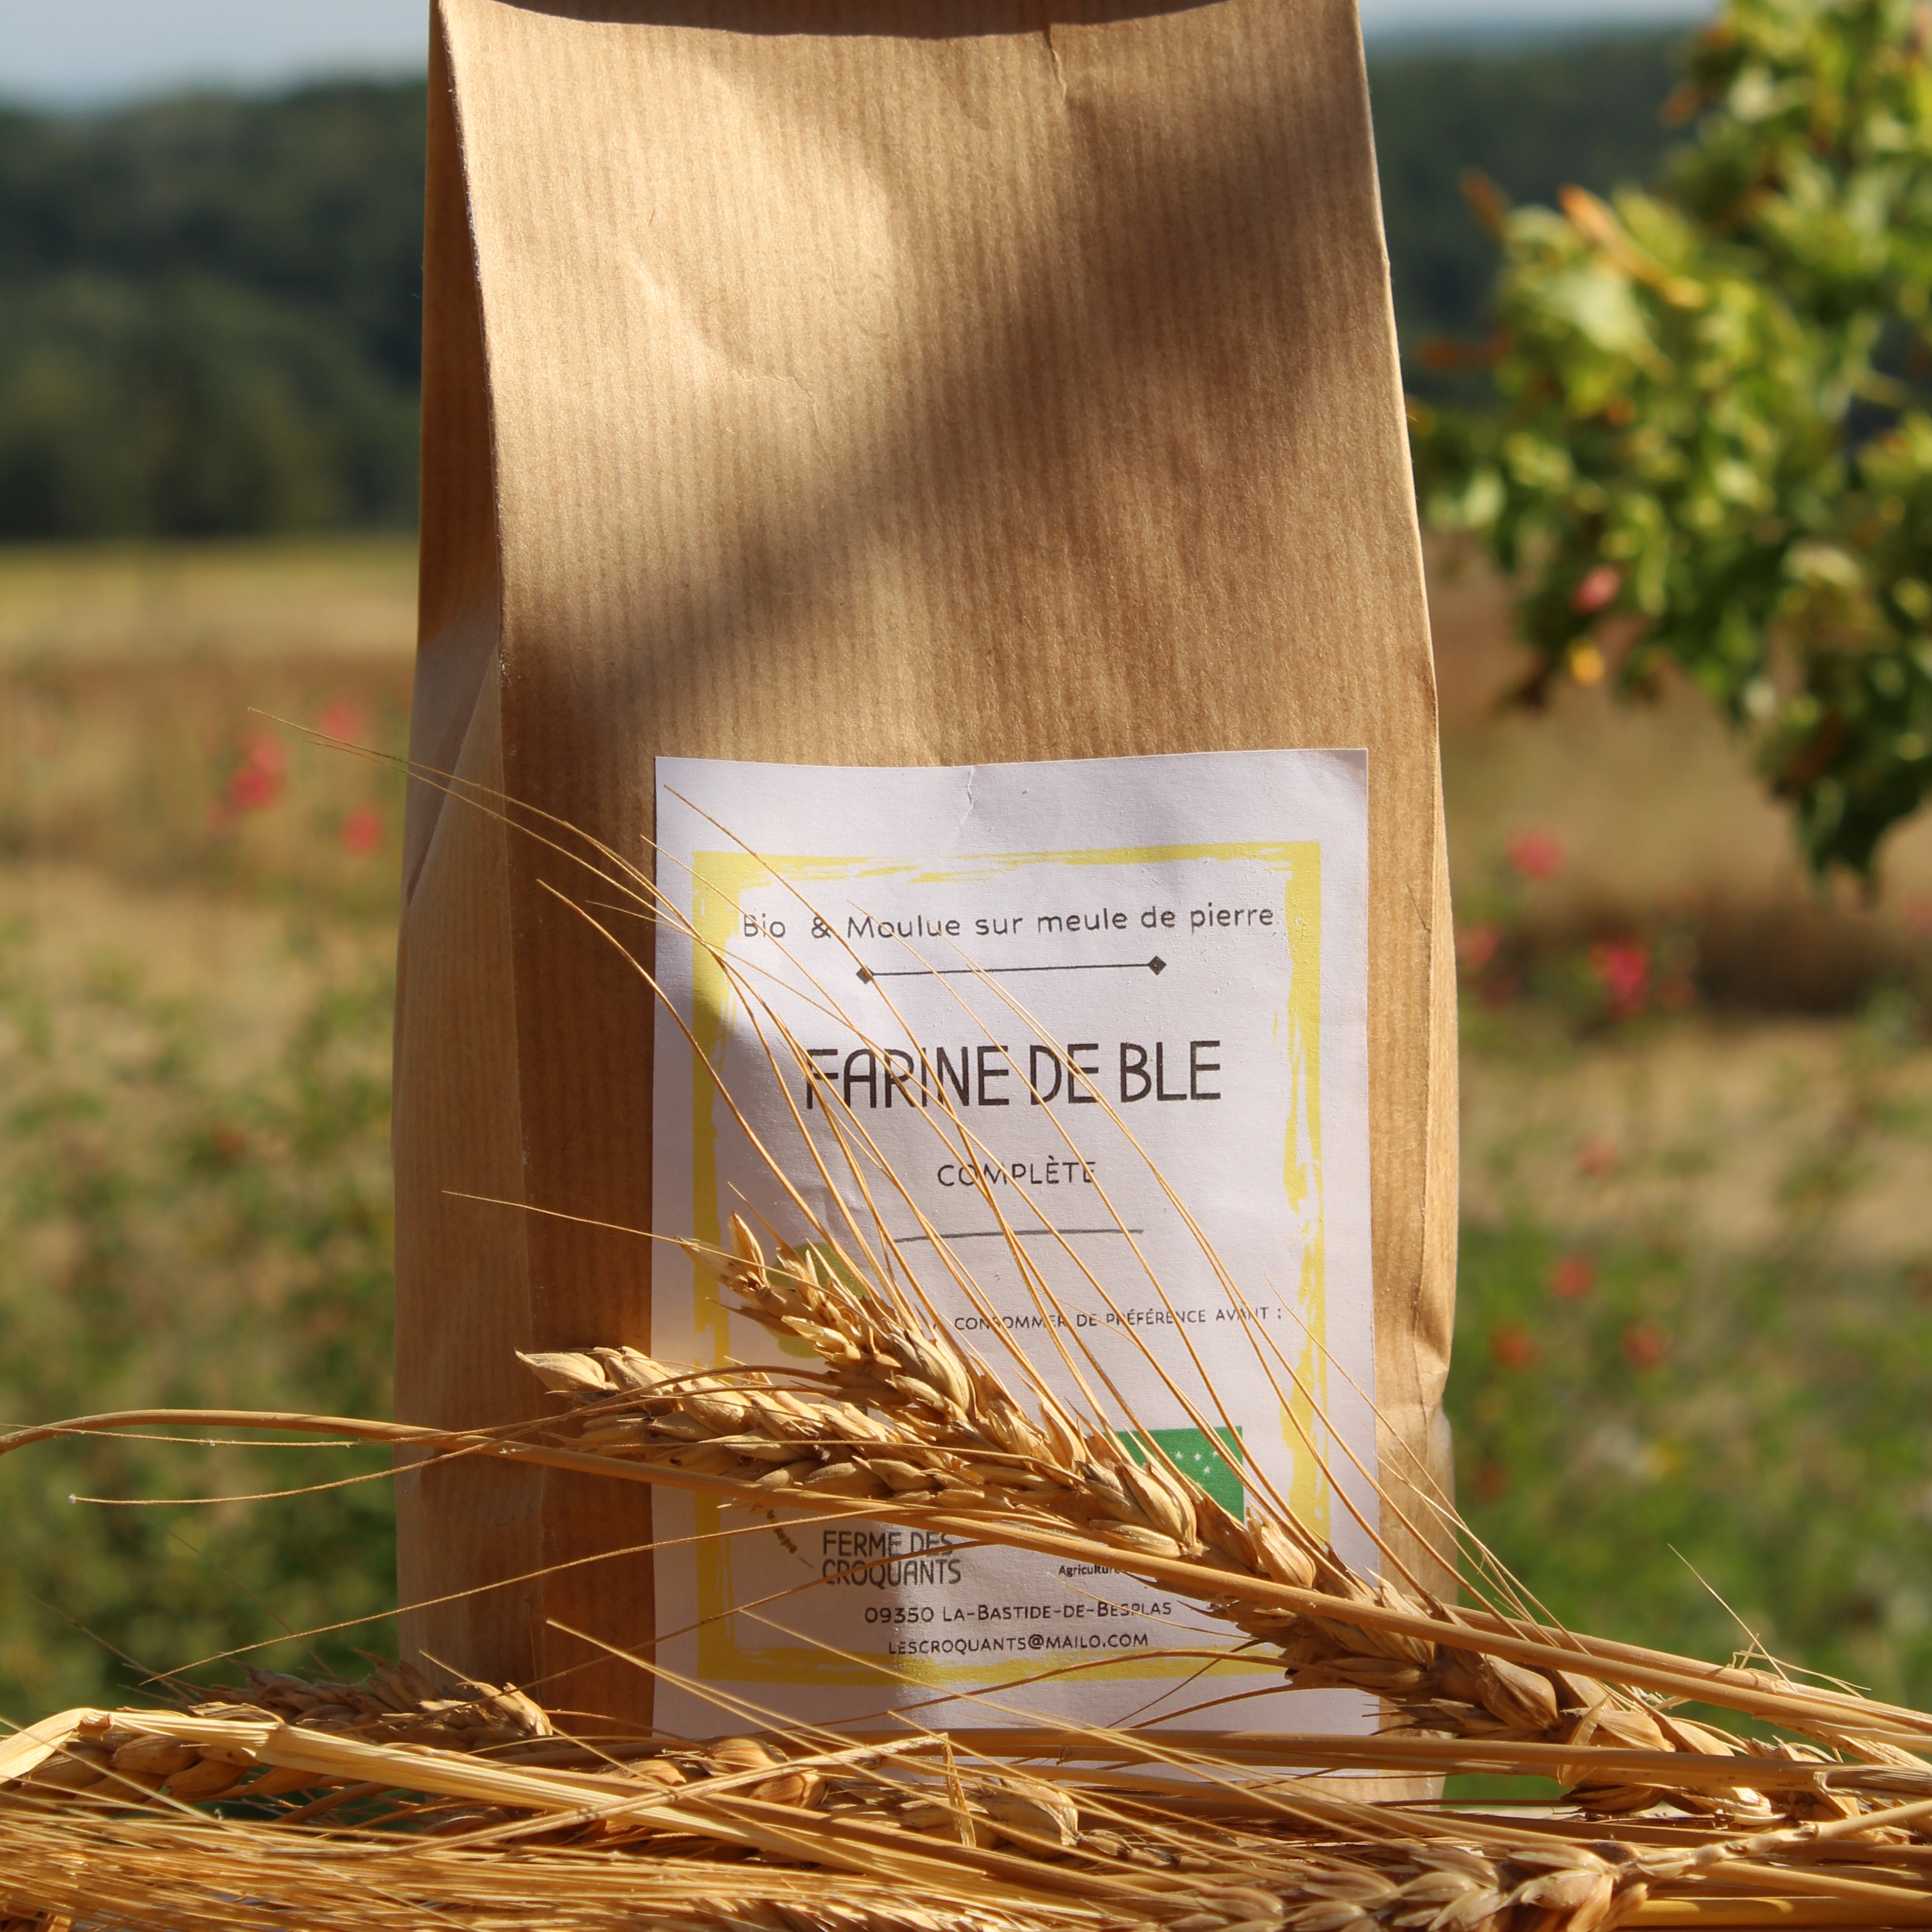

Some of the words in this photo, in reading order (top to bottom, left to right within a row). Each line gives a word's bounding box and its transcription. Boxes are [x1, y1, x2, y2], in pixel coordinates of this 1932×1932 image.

[744, 913, 786, 938] Bio
[811, 916, 831, 939] &
[847, 915, 960, 939] Moulue
[976, 915, 1023, 935] sur
[1038, 908, 1128, 933] meule
[1140, 906, 1175, 928] de
[1191, 902, 1274, 934] pierre
[806, 1045, 1010, 1110] FARINE
[1029, 1043, 1099, 1105] DE
[1120, 1040, 1221, 1103] BLE
[937, 1155, 1096, 1187] COMPLÈTE
[1076, 1314, 1097, 1328] DE
[1277, 1308, 1282, 1319] :
[823, 1530, 902, 1558] FERME
[910, 1531, 954, 1557] DES
[822, 1558, 962, 1590] CROQUANTS
[864, 1606, 935, 1624] 09350
[889, 1633, 1149, 1655] LESCROQUANTS@MAILO.COM
